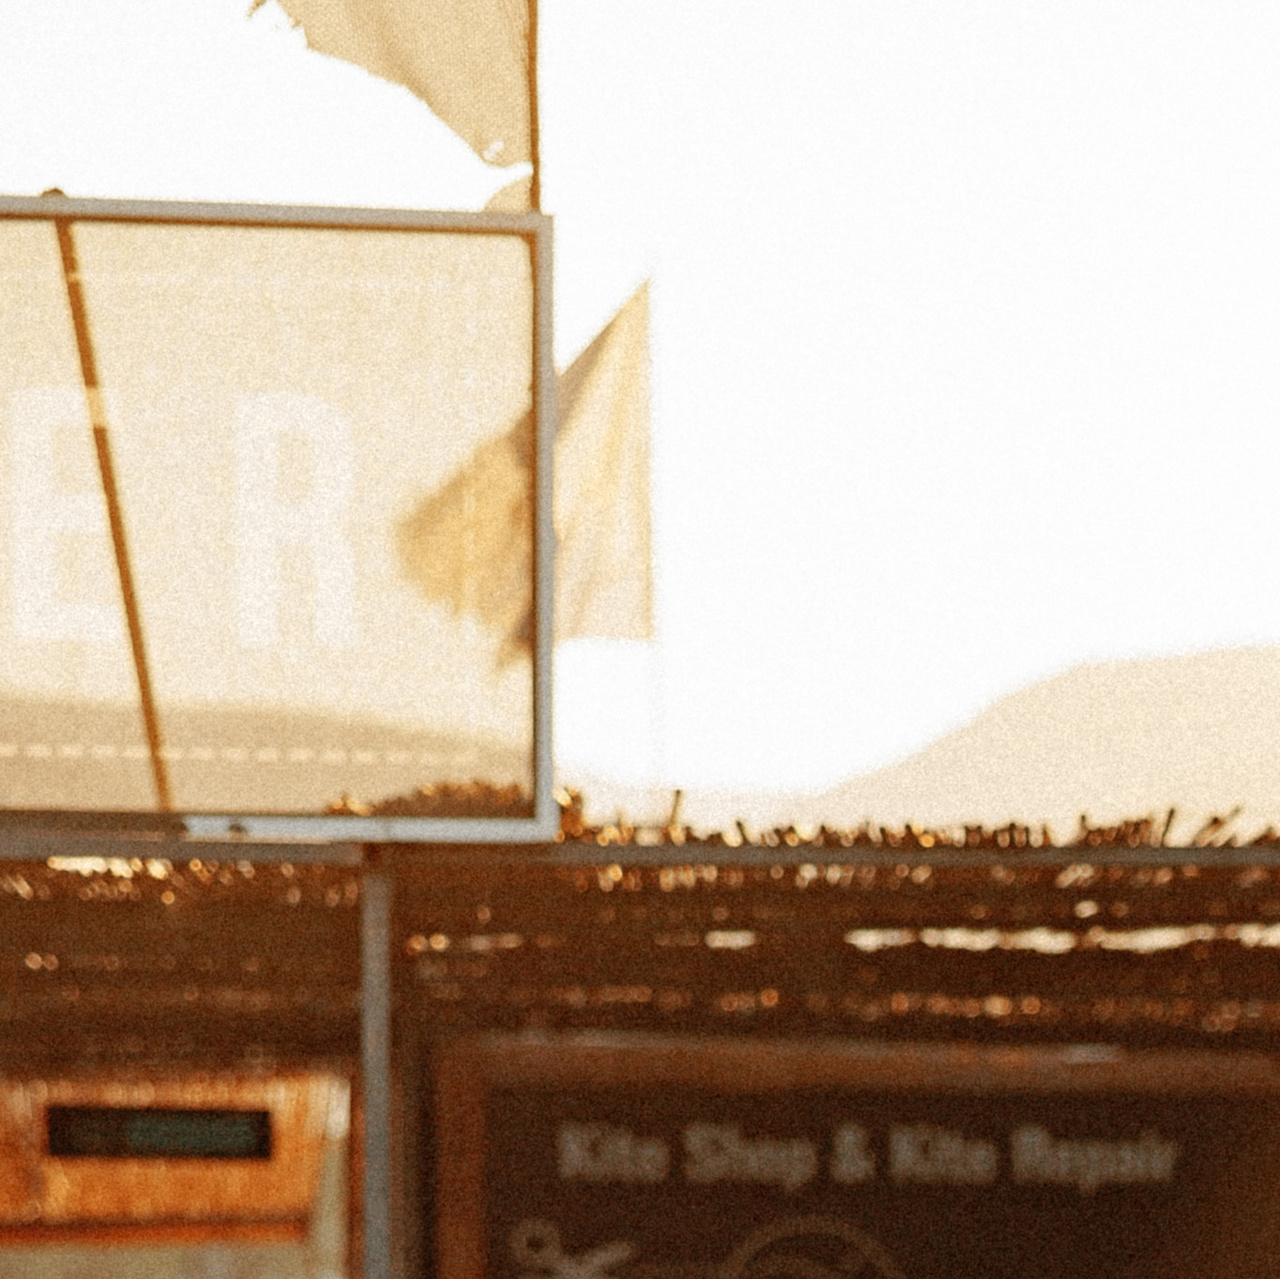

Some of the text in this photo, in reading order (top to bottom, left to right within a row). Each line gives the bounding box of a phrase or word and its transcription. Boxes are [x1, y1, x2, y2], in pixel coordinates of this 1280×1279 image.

[557, 1121, 1178, 1192] Kite Shop & Kite Repair
